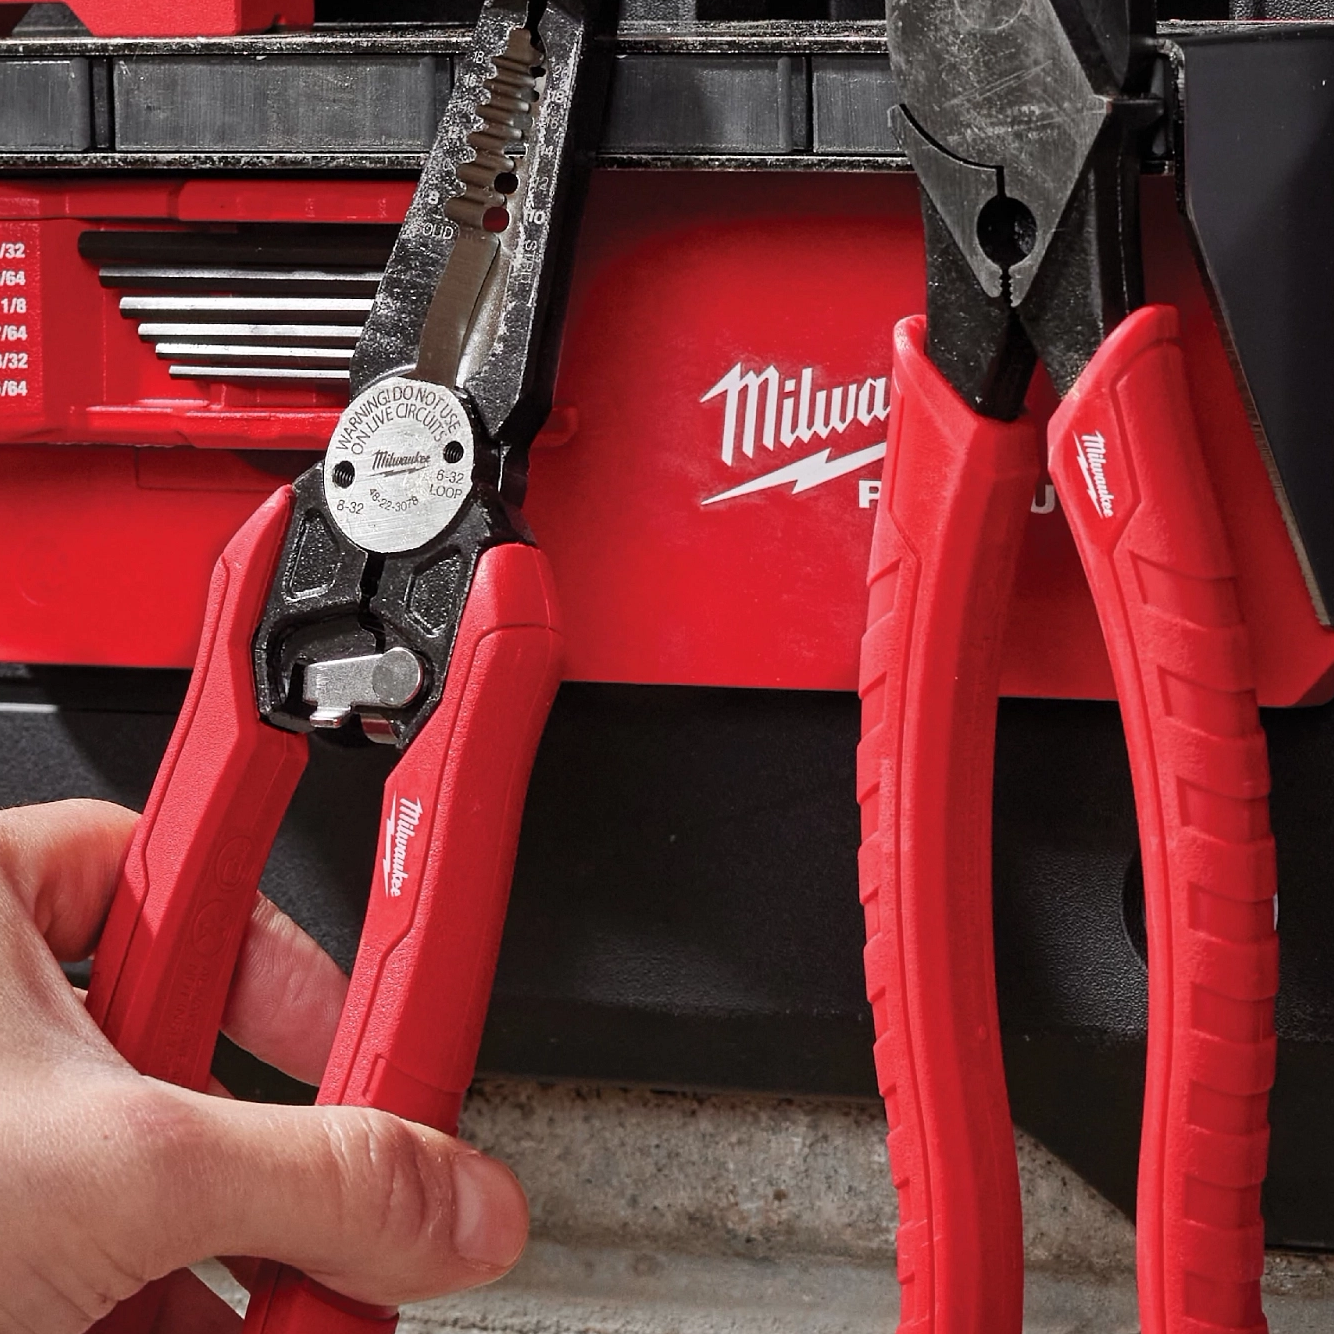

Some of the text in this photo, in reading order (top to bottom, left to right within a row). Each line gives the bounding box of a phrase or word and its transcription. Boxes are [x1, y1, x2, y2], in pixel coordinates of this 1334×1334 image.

[0, 297, 27, 314] 1/8
[335, 385, 462, 451] WARNING! DO NOT USE
[351, 402, 448, 456] ON LIVE CIRCUITS
[700, 362, 891, 467] Milwa
[372, 449, 431, 471] Milwaukee
[436, 469, 465, 485] 6-32
[1081, 430, 1115, 518] Milwaukee
[336, 499, 364, 515] 8-32
[429, 483, 463, 500] LOOP
[390, 796, 424, 897] Milwaukee
